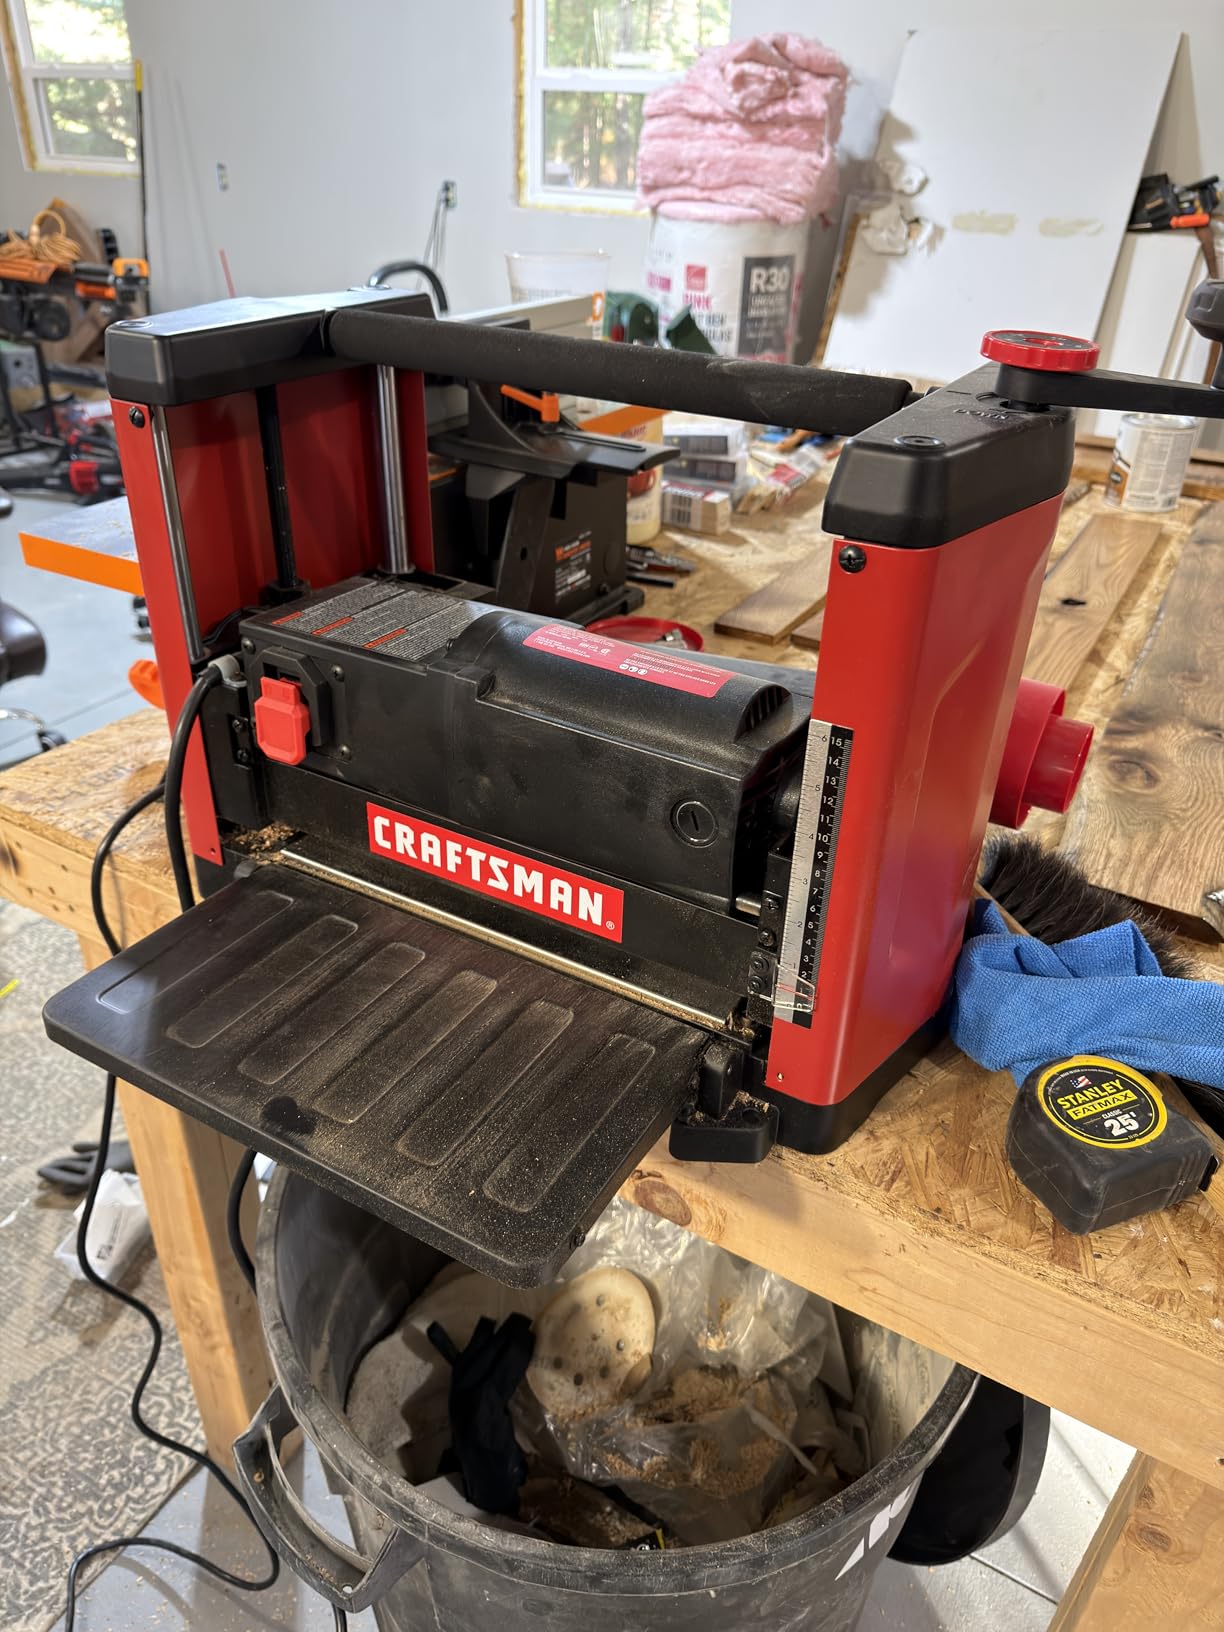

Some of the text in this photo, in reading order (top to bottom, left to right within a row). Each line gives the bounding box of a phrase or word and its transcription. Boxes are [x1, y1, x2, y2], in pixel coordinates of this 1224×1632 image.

[751, 265, 790, 293] R30
[821, 734, 828, 743] 6
[831, 736, 842, 747] 15
[828, 756, 839, 766] 14
[825, 775, 837, 785] 13
[822, 795, 834, 806] 12
[820, 814, 830, 824] 11
[817, 832, 829, 843] 10
[817, 851, 824, 859] 9
[374, 815, 603, 926] CRAFTSMAN
[814, 870, 820, 878] 8
[812, 887, 819, 895] 7
[809, 905, 816, 913] 6
[807, 921, 814, 929] 5
[801, 971, 807, 979] 2
[1057, 1079, 1124, 1109] STANLEY
[1073, 1092, 1132, 1117] FATMAX
[1104, 1111, 1139, 1137] 25'
